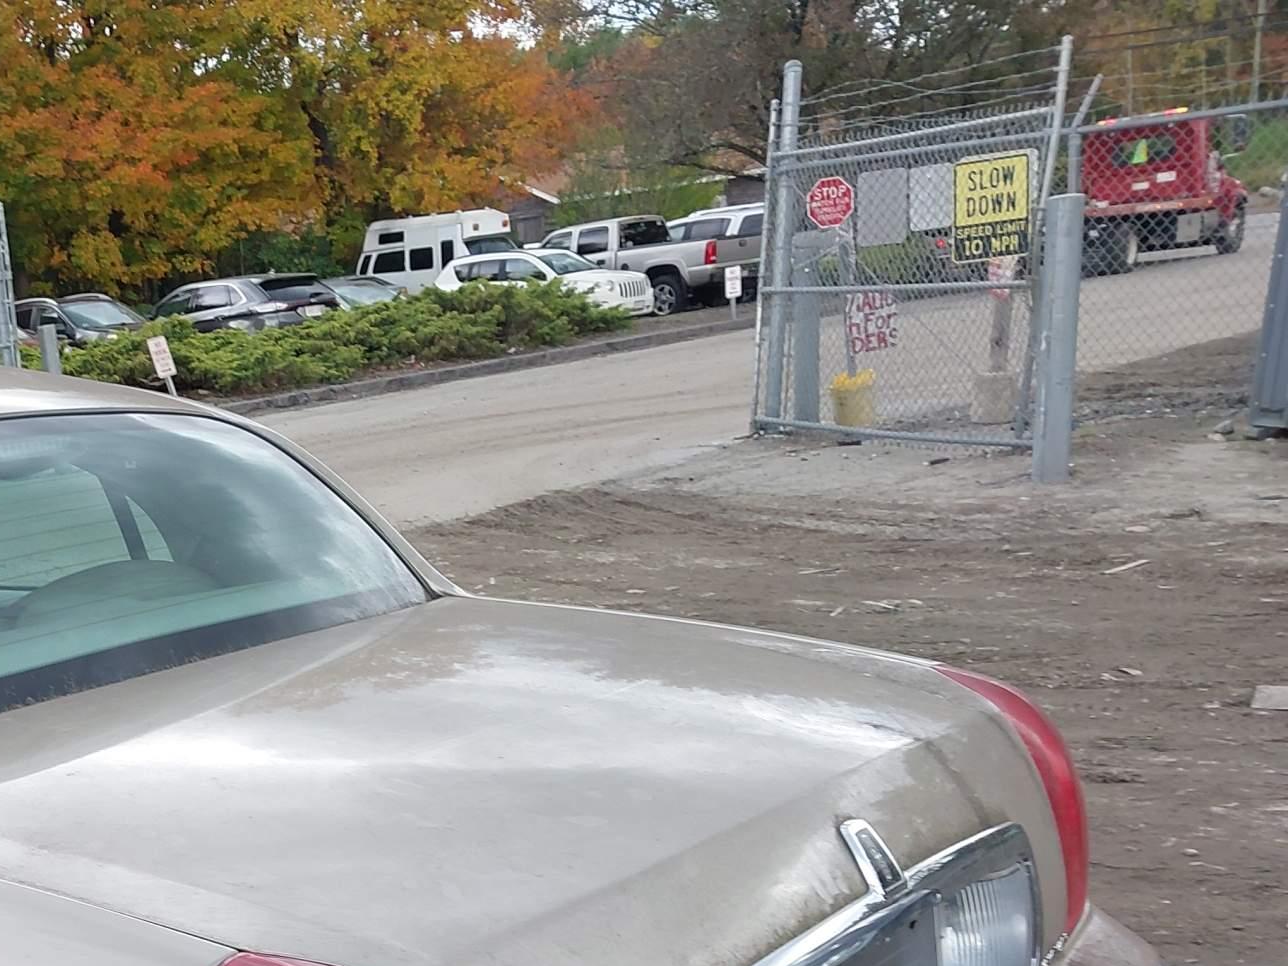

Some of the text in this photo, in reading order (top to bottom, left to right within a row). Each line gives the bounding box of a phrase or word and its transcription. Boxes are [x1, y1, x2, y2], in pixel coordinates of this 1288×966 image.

[967, 165, 1016, 191] SLOW
[813, 184, 847, 201] STOP
[966, 190, 1017, 218] DOWN
[956, 221, 1027, 239] SPEED LIMIT
[963, 234, 1019, 257] 10 MPH
